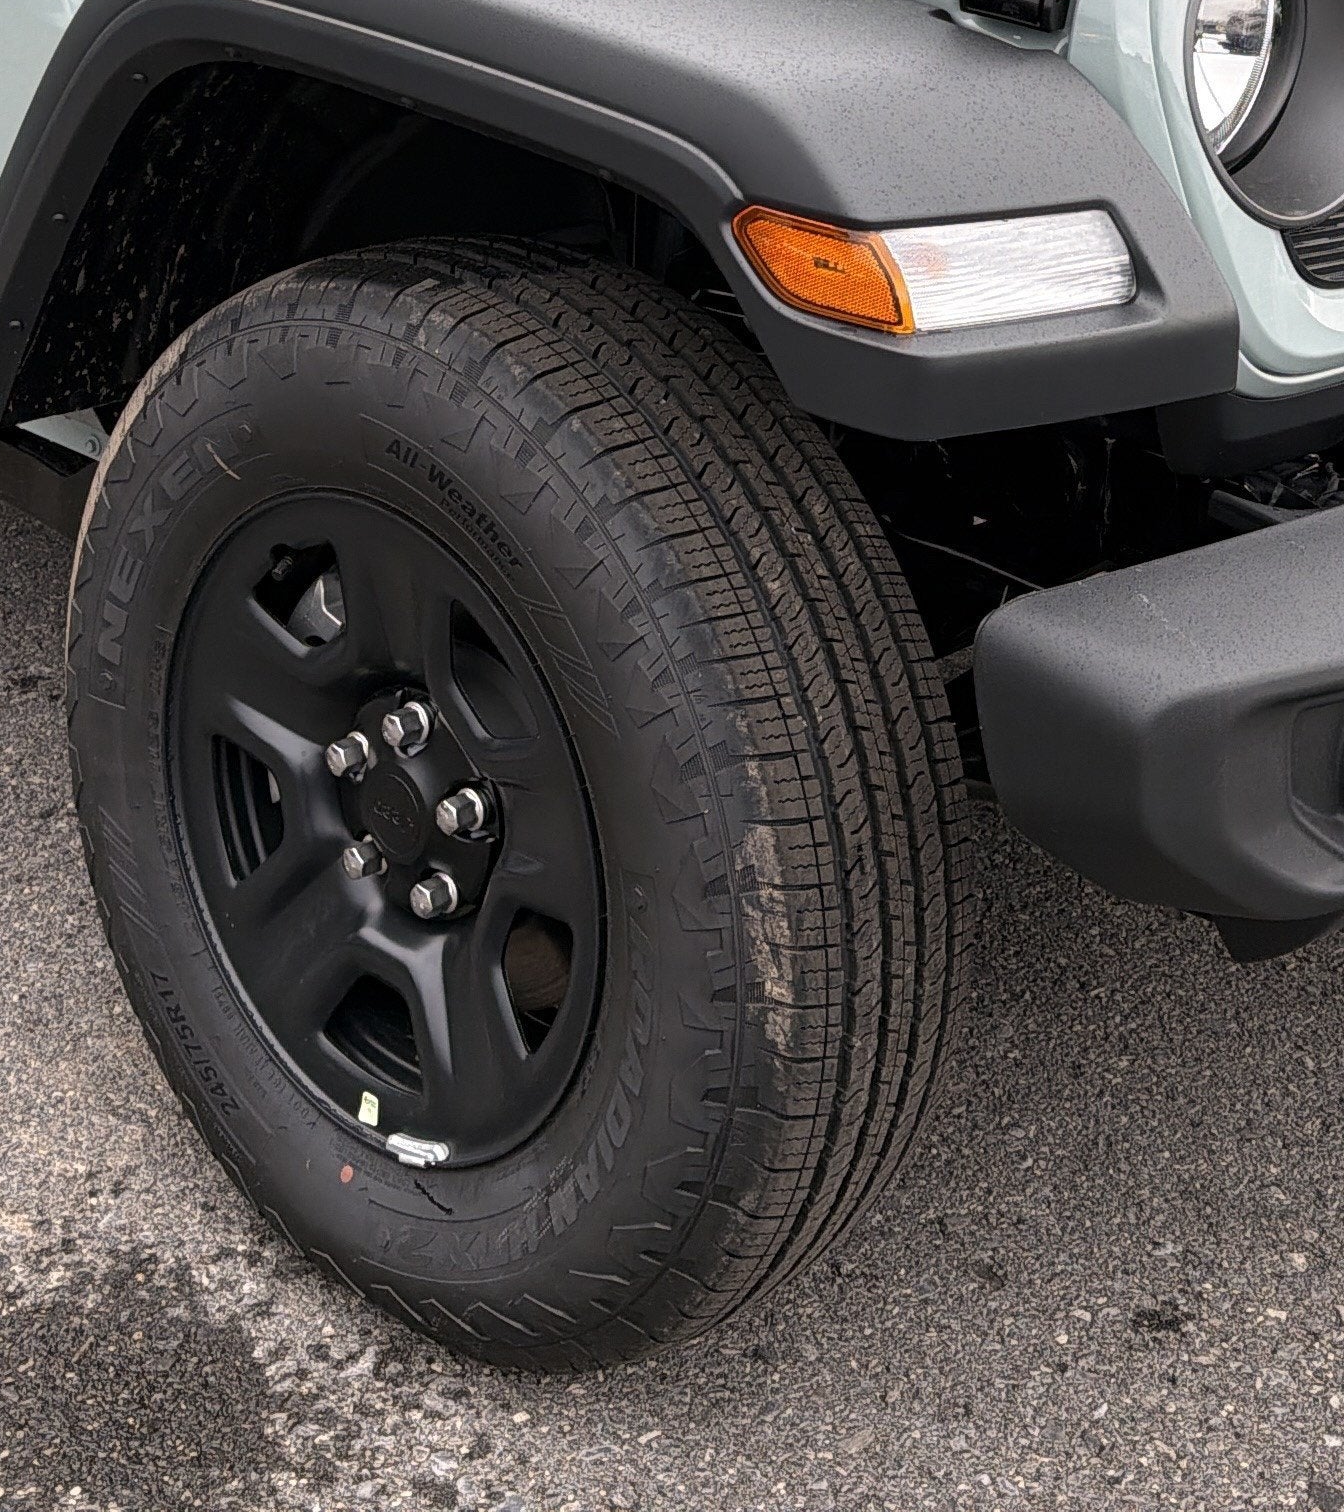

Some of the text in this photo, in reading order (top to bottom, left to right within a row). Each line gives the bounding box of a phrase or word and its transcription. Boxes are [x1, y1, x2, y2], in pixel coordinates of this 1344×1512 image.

[97, 424, 241, 666] NEXEN
[384, 437, 524, 569] All-Weather
[148, 970, 242, 1116] 245/75R17
